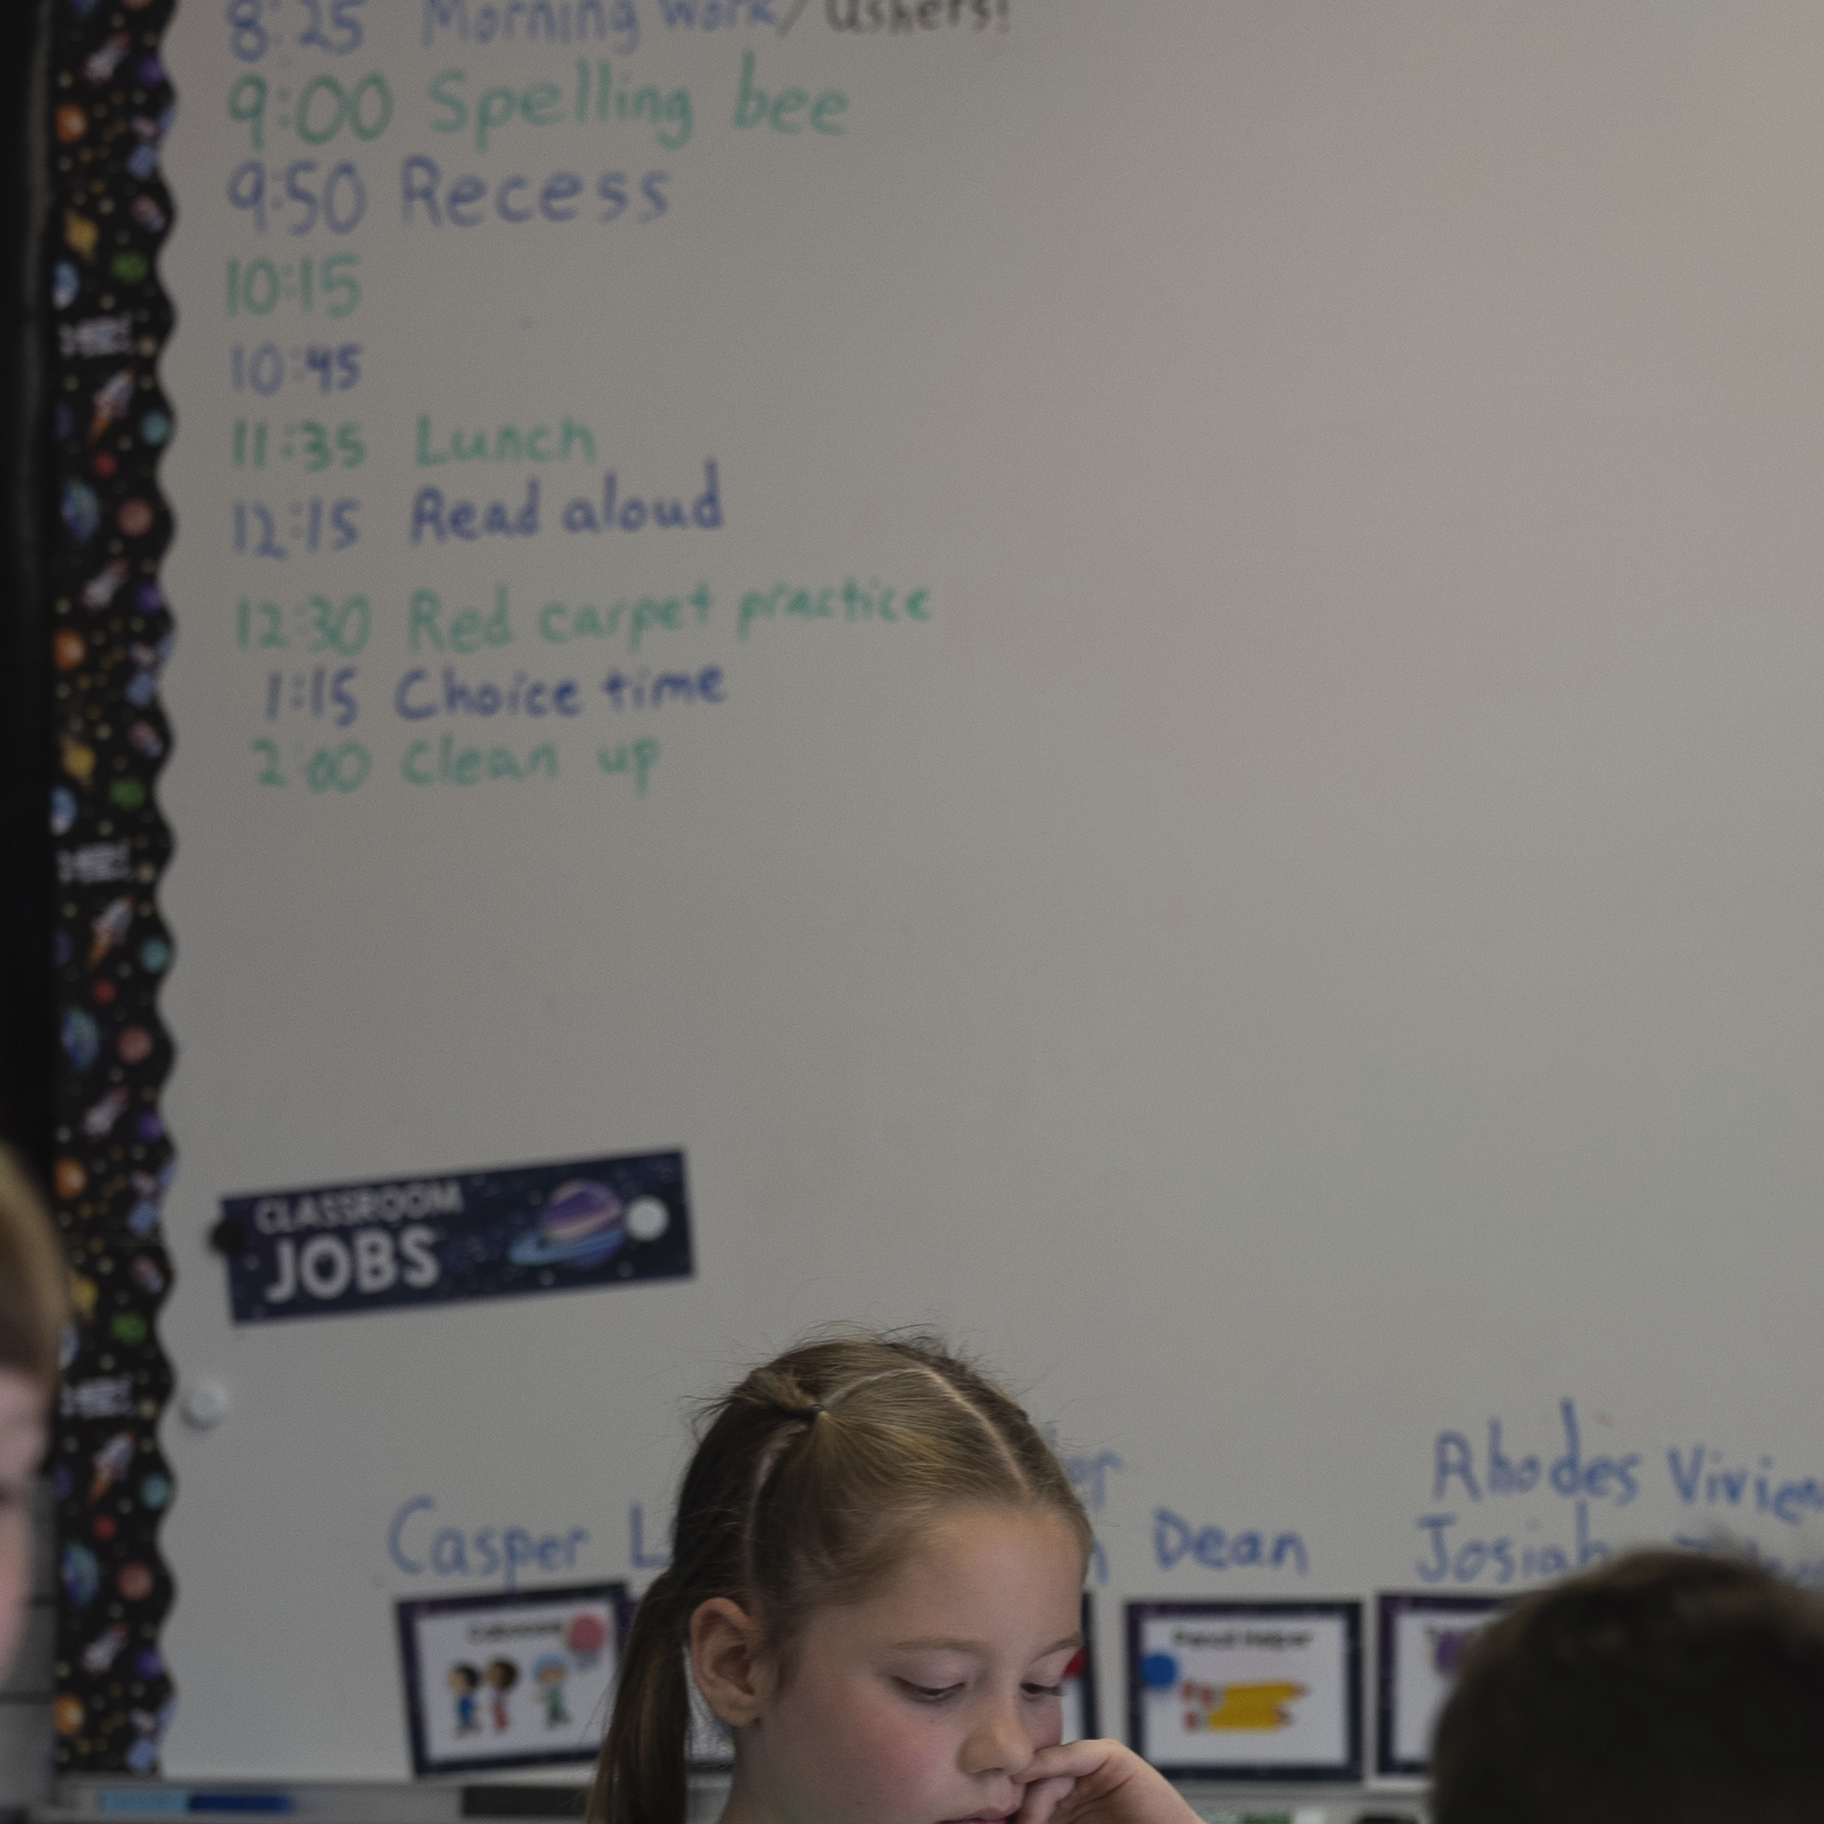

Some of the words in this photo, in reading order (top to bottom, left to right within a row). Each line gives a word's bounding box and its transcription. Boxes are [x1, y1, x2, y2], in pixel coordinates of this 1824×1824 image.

[225, 0, 365, 62] 8:25
[421, 0, 640, 54] Morning
[226, 71, 393, 151] 9:00
[428, 60, 694, 152] Spelling
[733, 48, 850, 136] bee
[226, 158, 366, 236] 9:50
[400, 156, 670, 229] Recess
[226, 254, 361, 317] 10:15
[232, 344, 361, 395] 10:45
[232, 418, 366, 473] 11:35
[416, 416, 598, 470] Lunch
[233, 497, 360, 562] 12:15
[411, 478, 541, 545] Read
[561, 458, 724, 534] aloud
[236, 594, 372, 656] 12:30
[408, 586, 514, 656] Red
[537, 583, 711, 654] carpet
[736, 578, 933, 641] practice
[266, 666, 359, 728] 1:15
[393, 667, 582, 723] Choice
[601, 666, 727, 707] time
[400, 735, 559, 788] Clean
[597, 738, 661, 794] up
[254, 1179, 464, 1236] CLASSROOM
[264, 1223, 442, 1304] JOBS
[1432, 1397, 1643, 1509] Rhodes
[387, 1495, 590, 1590] Casper
[1152, 1507, 1310, 1575] Dean
[1415, 1500, 1612, 1585] Josiah
